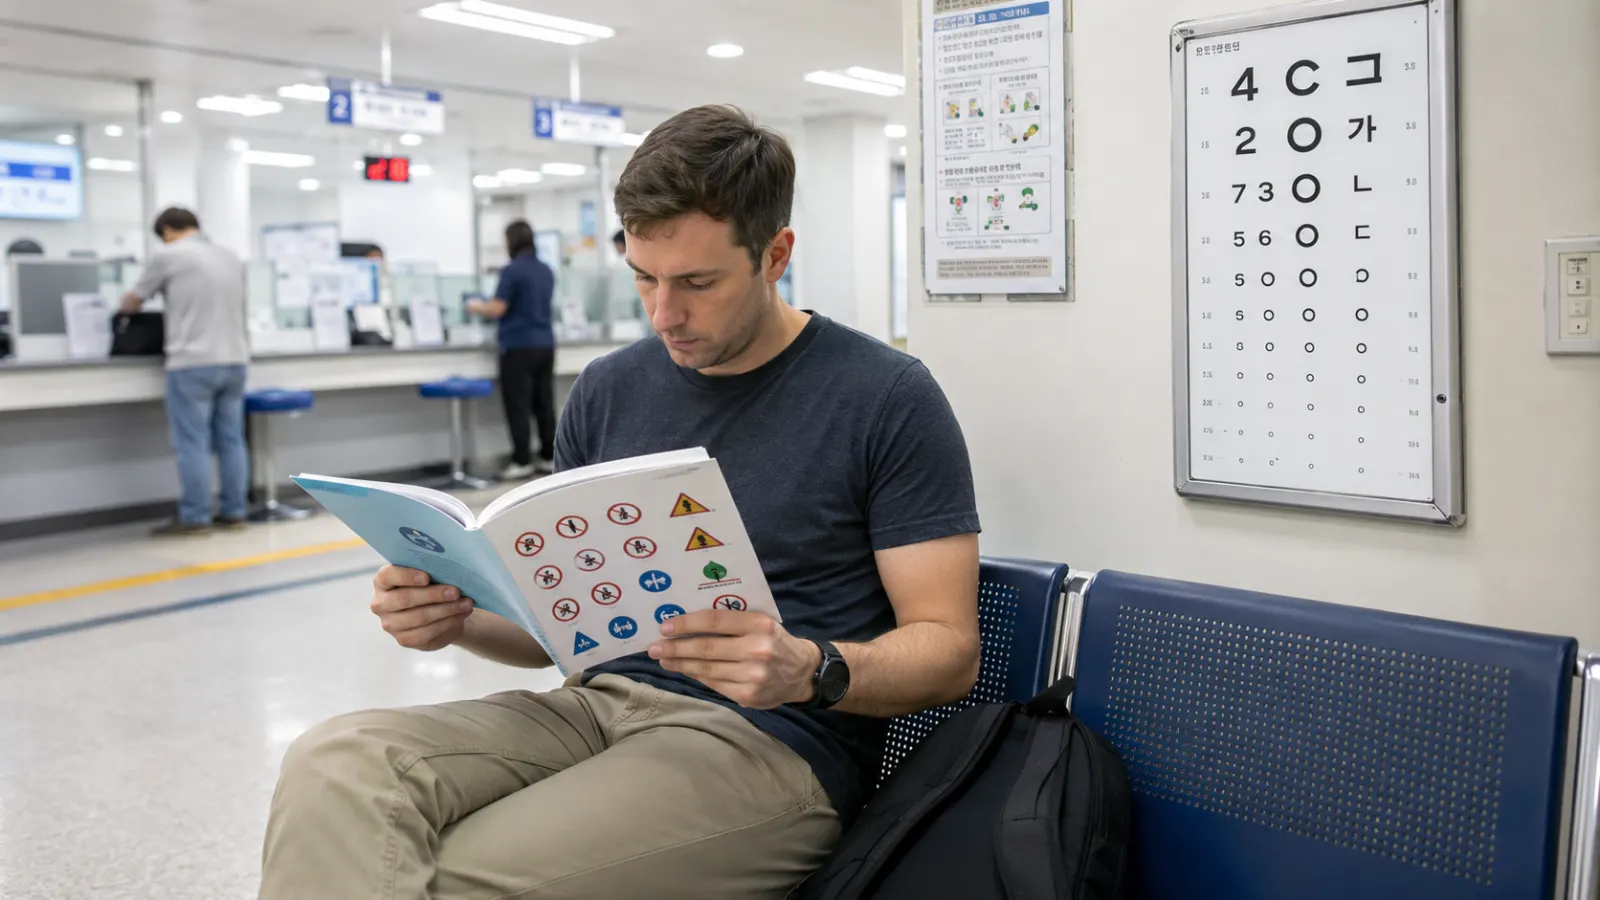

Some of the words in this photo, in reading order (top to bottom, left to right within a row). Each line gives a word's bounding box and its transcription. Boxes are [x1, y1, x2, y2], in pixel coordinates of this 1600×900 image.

[1231, 67, 1258, 101] 4
[1285, 60, 1320, 96] C
[331, 94, 349, 118] 2
[1235, 127, 1256, 155] 2
[1348, 115, 1376, 142] 가
[1232, 184, 1246, 203] 7
[1258, 182, 1274, 202] 3
[1234, 231, 1245, 247] 5
[1259, 230, 1271, 246] 6
